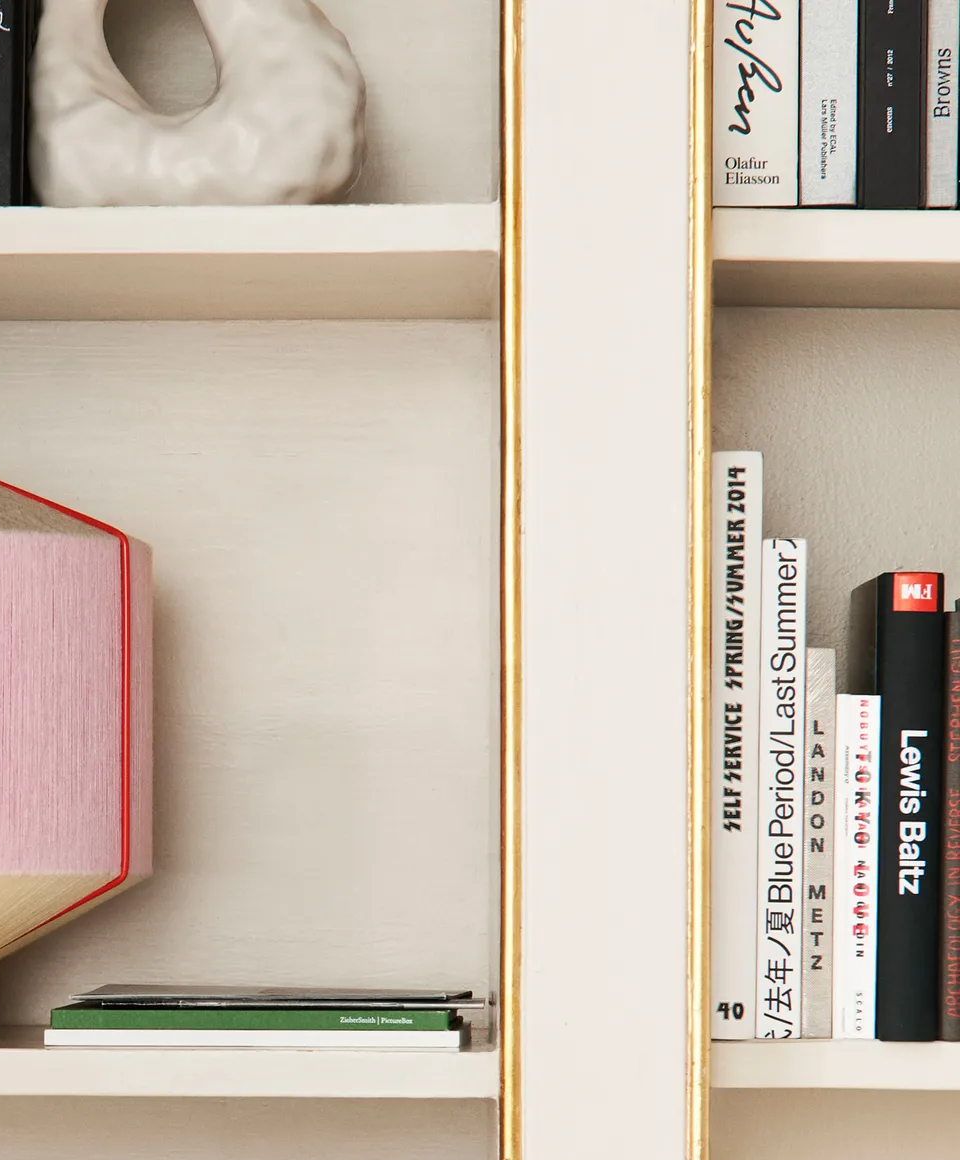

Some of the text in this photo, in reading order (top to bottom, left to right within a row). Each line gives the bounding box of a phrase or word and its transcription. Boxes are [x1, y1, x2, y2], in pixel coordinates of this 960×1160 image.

[934, 48, 951, 117] Browns
[829, 124, 836, 132] by
[725, 157, 767, 169] Olafur
[726, 173, 779, 184] Eliasson
[728, 467, 745, 513] 2014
[770, 552, 797, 672] Summer
[900, 582, 932, 600] FM
[724, 704, 742, 781] SERVICE
[769, 677, 795, 837] Period/Last
[723, 788, 741, 831] SELF
[899, 730, 928, 895] Lewis Baltz
[768, 843, 793, 903] Blue
[808, 720, 826, 970] LANDON METZ
[852, 863, 873, 938] LOVE
[717, 1003, 744, 1020] 40
